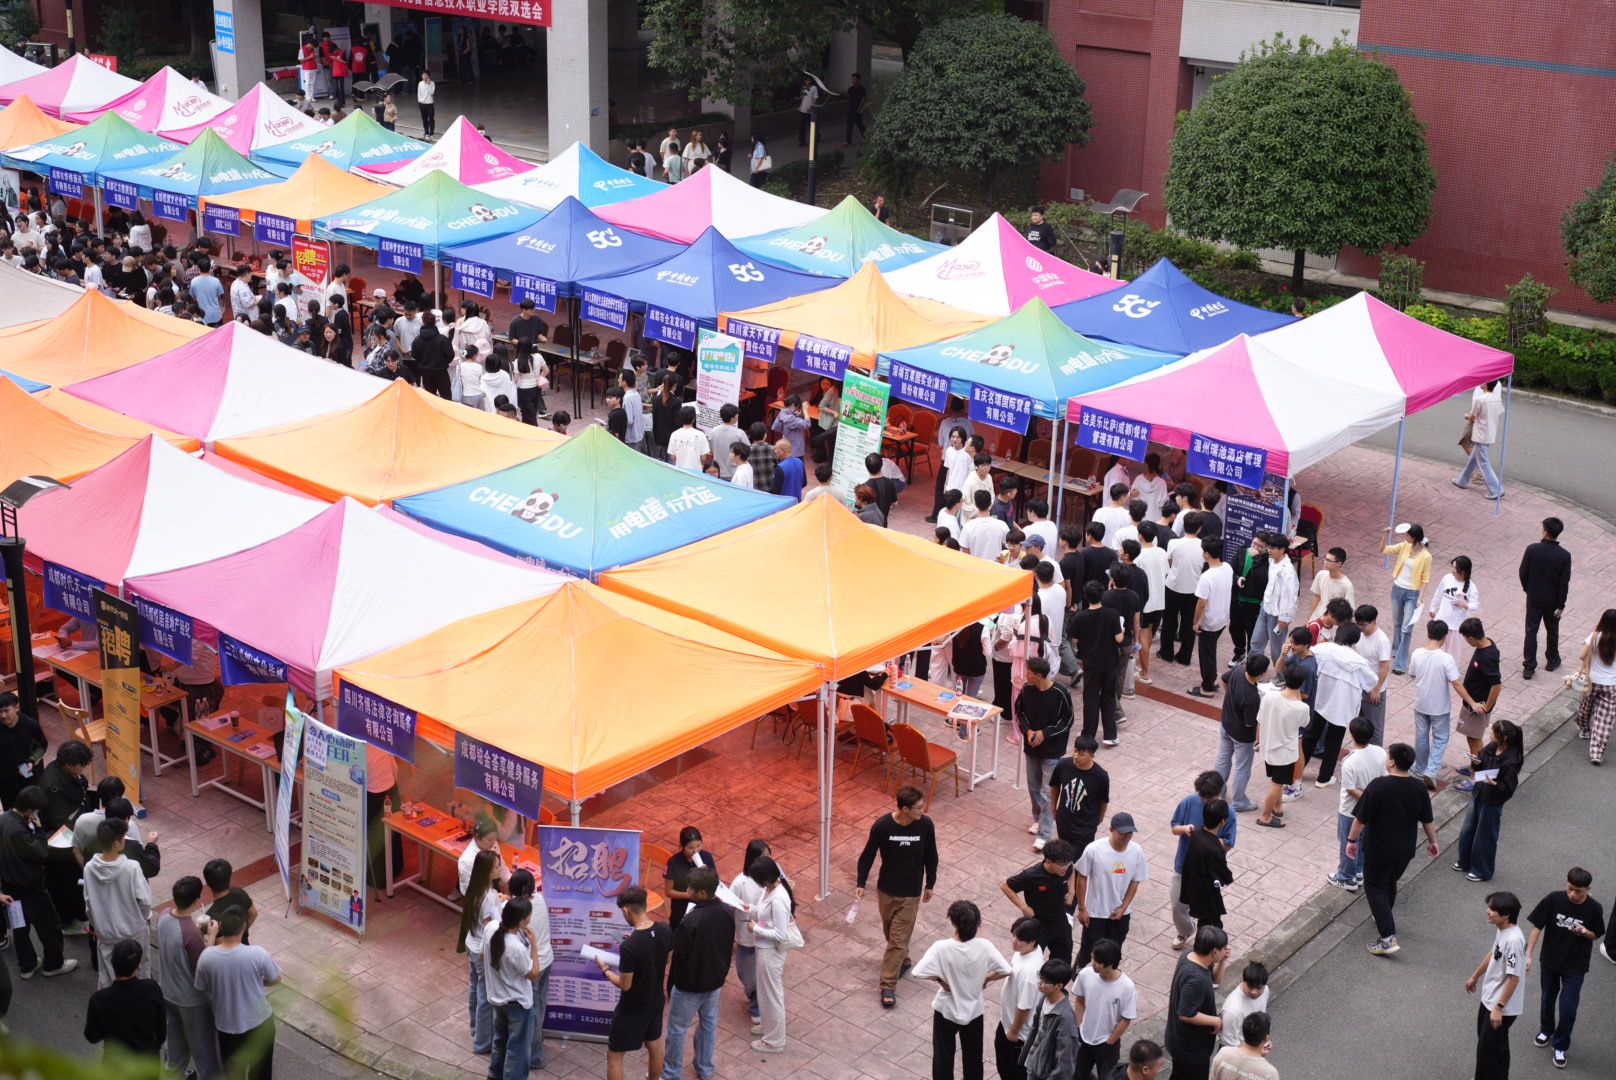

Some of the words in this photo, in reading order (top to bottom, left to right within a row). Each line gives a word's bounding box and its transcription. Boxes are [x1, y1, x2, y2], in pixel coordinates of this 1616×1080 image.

[266, 229, 286, 242] 有限公司
[461, 276, 488, 292] 有限公司
[525, 291, 546, 306] 有限公司
[662, 326, 683, 342] 有限公司
[728, 323, 777, 344] 四川家天下置业
[806, 355, 837, 373] 有限公司
[901, 382, 936, 404] 股份有限公司
[974, 388, 1031, 414] 重庆名瑞国际贸易
[1082, 412, 1148, 441] 达美乐比萨(成都)餐饮
[1092, 430, 1134, 453] 管理有限公司
[1193, 438, 1263, 469] 温州瑞池酒店管理
[1208, 459, 1243, 480] 有限公司
[62, 591, 90, 616] 有限公司
[153, 626, 175, 651] 有限公司
[365, 718, 394, 746] 有限公司
[484, 772, 516, 803] 有限公司
[547, 836, 633, 898] 招聘
